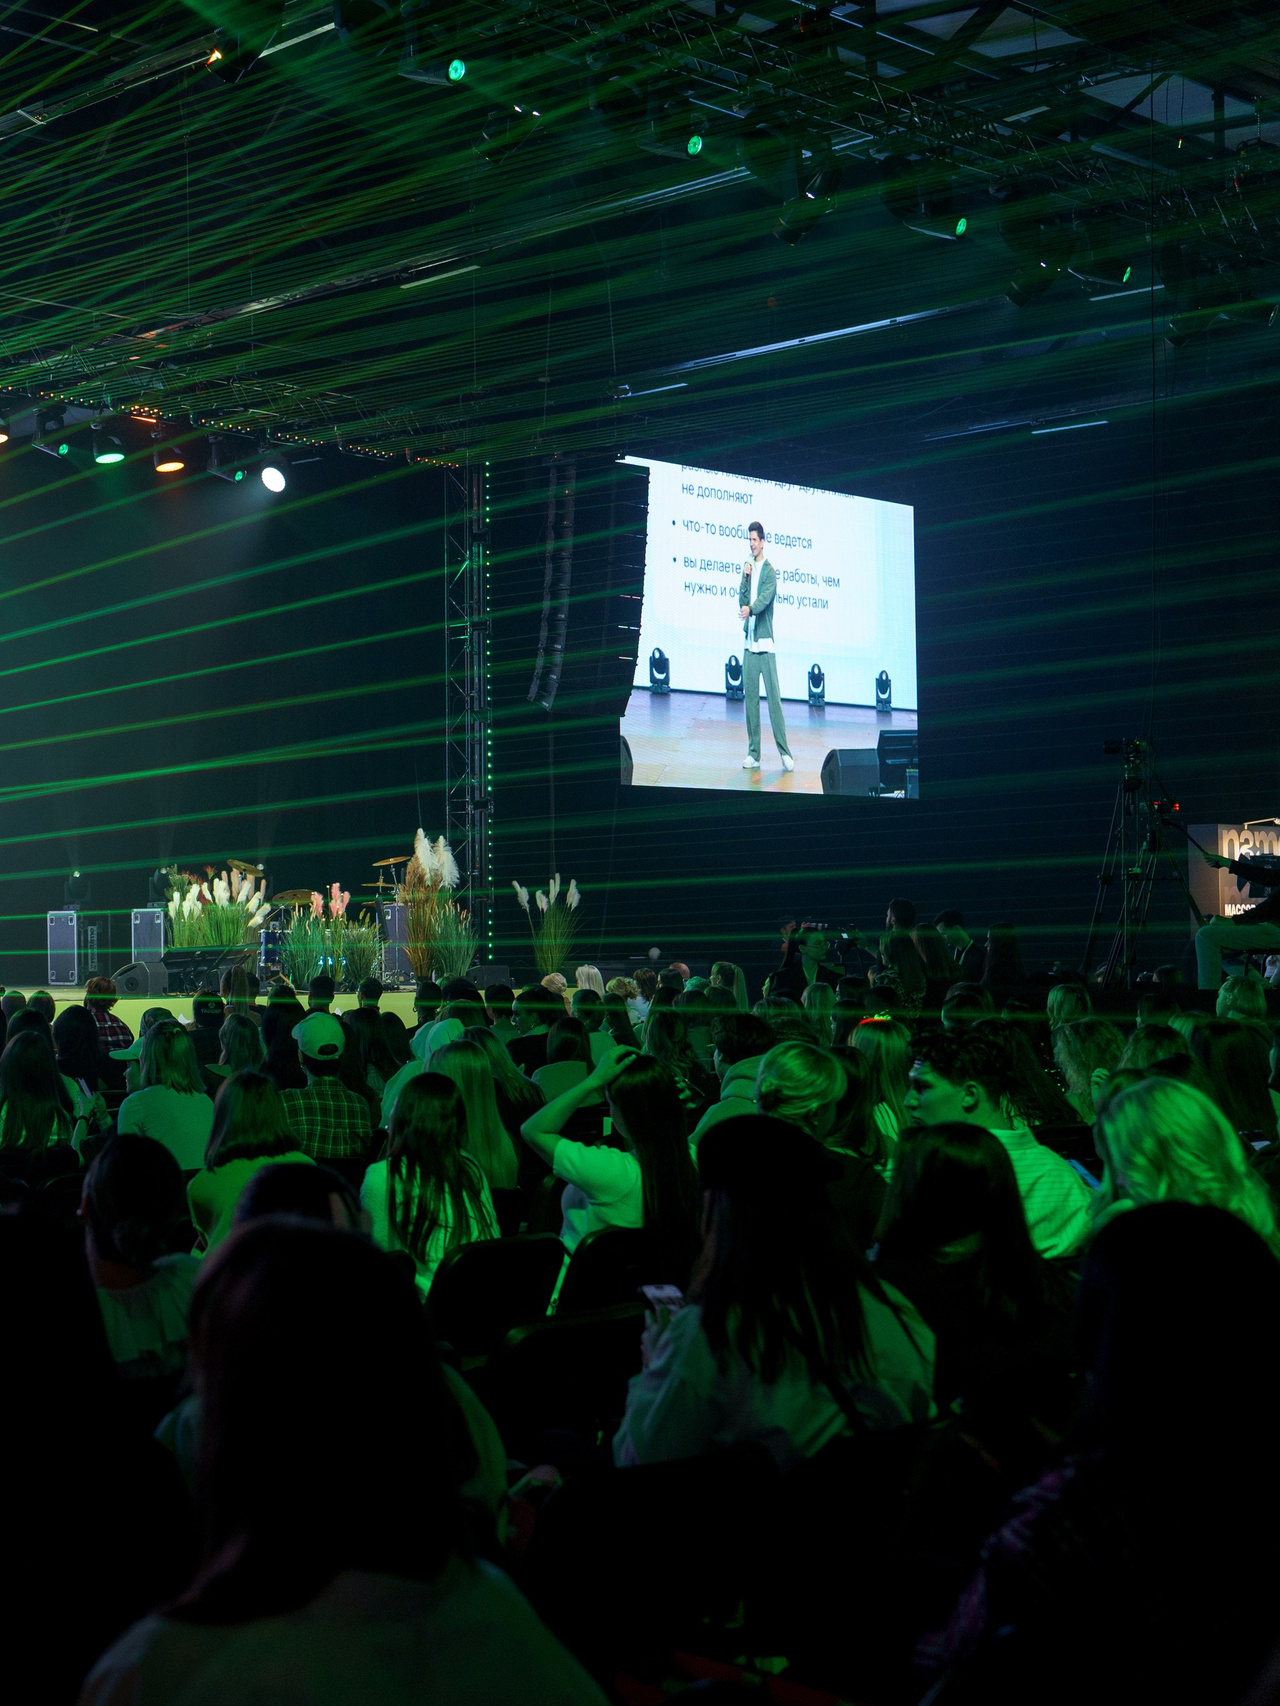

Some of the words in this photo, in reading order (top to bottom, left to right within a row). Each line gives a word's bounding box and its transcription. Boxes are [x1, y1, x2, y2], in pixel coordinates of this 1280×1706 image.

[682, 484, 694, 495] не
[697, 486, 753, 504] дополняют
[683, 520, 716, 534] что-то
[718, 523, 750, 541] вообщ
[775, 534, 811, 548] ведется
[684, 557, 696, 568] вы
[700, 559, 741, 574] делаете
[783, 569, 819, 585] работы,
[823, 577, 839, 587] чем
[685, 582, 717, 596] нужно
[721, 587, 726, 596] и
[797, 596, 828, 609] устали
[1222, 829, 1280, 862] nam
